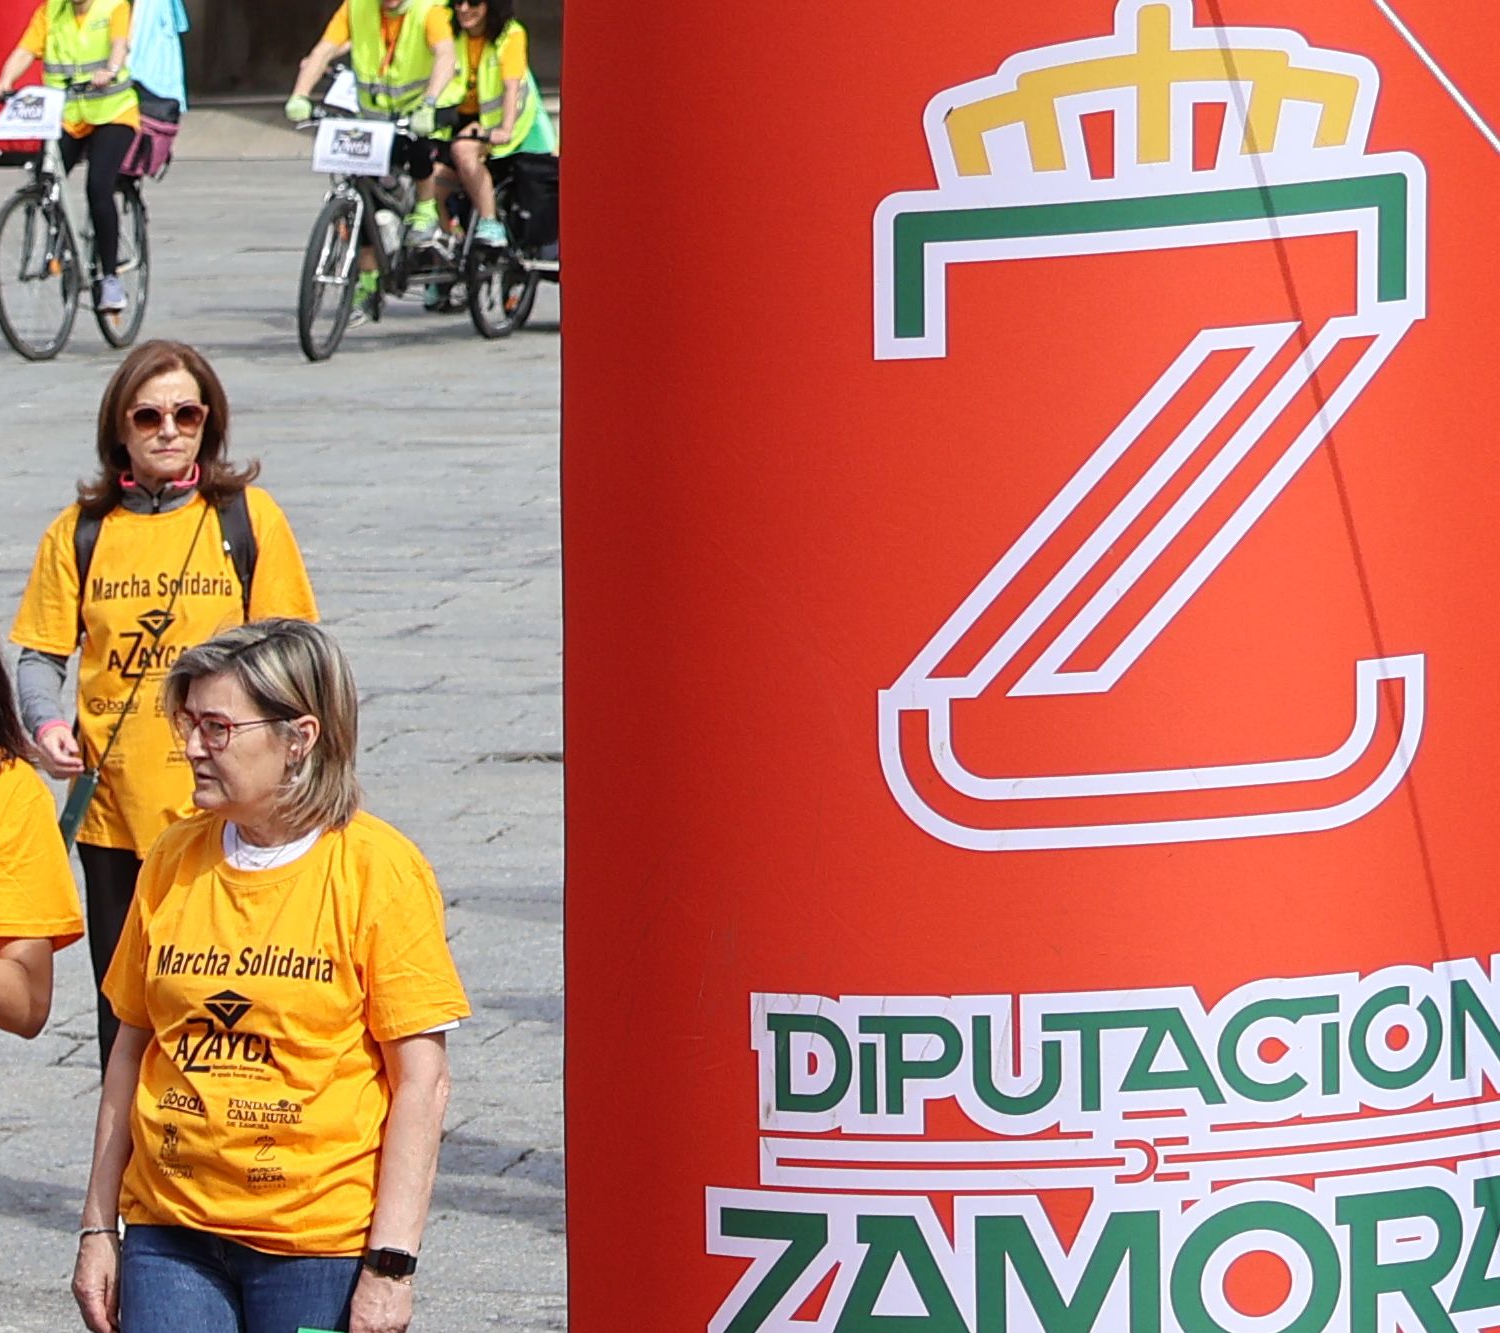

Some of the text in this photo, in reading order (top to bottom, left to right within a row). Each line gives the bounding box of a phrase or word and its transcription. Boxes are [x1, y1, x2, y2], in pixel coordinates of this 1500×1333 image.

[92, 572, 233, 602] Marcha Solidaria
[155, 943, 334, 985] Marcha Solidaria
